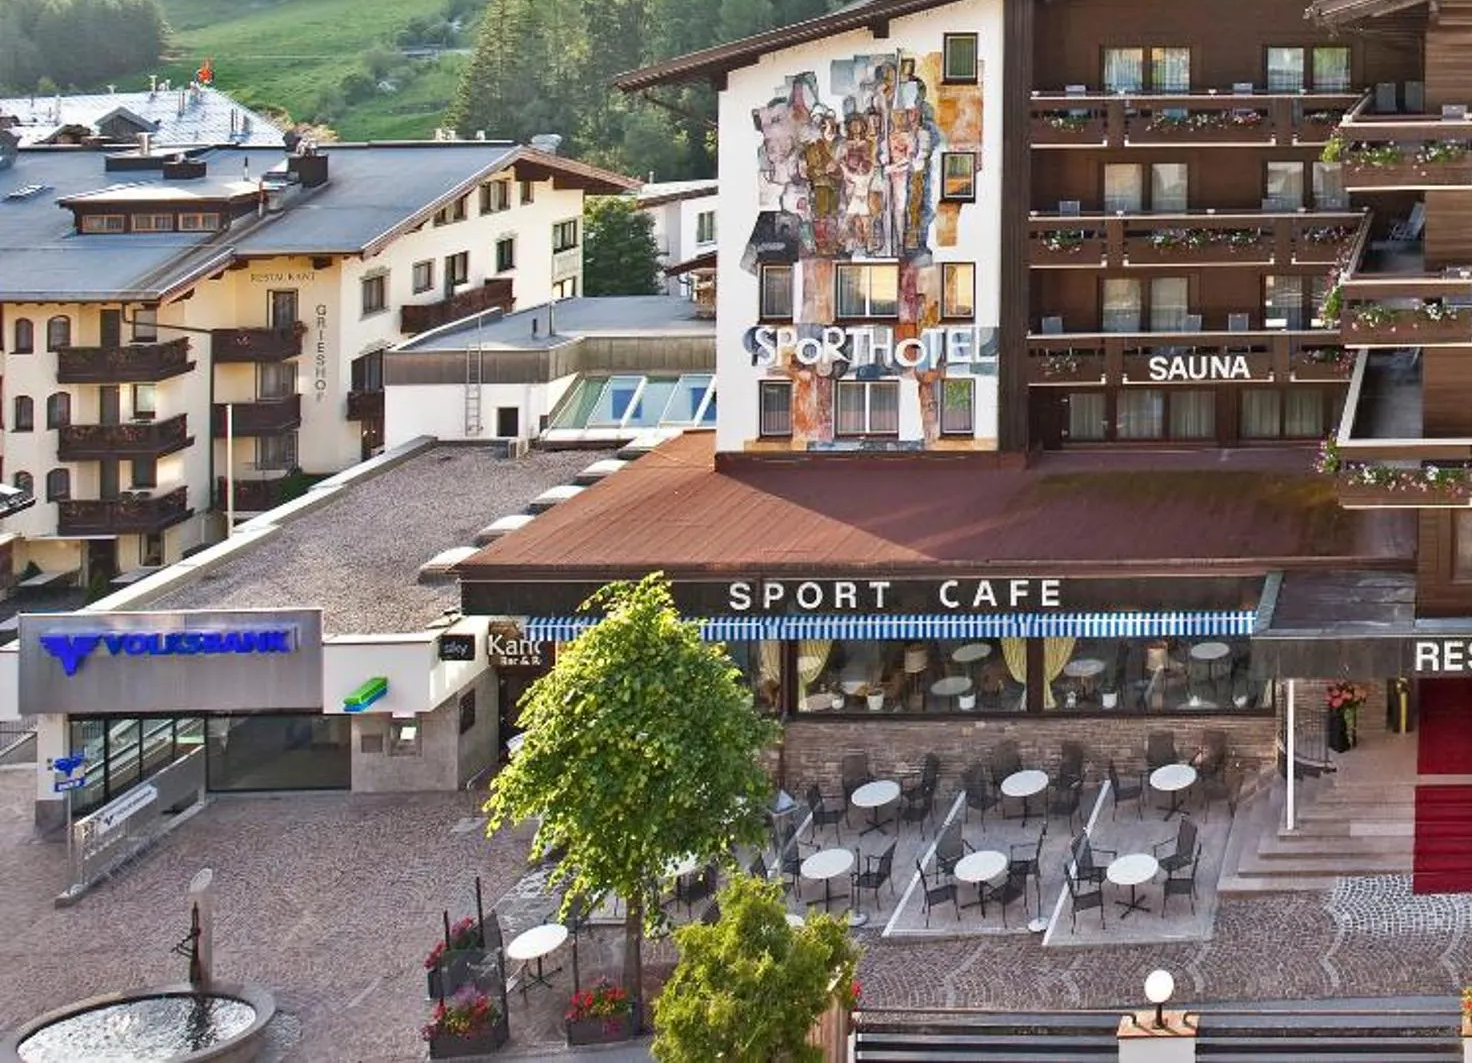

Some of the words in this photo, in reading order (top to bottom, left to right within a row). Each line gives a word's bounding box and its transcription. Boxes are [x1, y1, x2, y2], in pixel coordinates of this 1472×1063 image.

[755, 325, 996, 369] SPORTHOTEL
[1149, 356, 1251, 380] SAUNA
[729, 582, 890, 610] SPORT
[939, 580, 1060, 608] CAFE
[104, 632, 290, 655] VOLKSBANK
